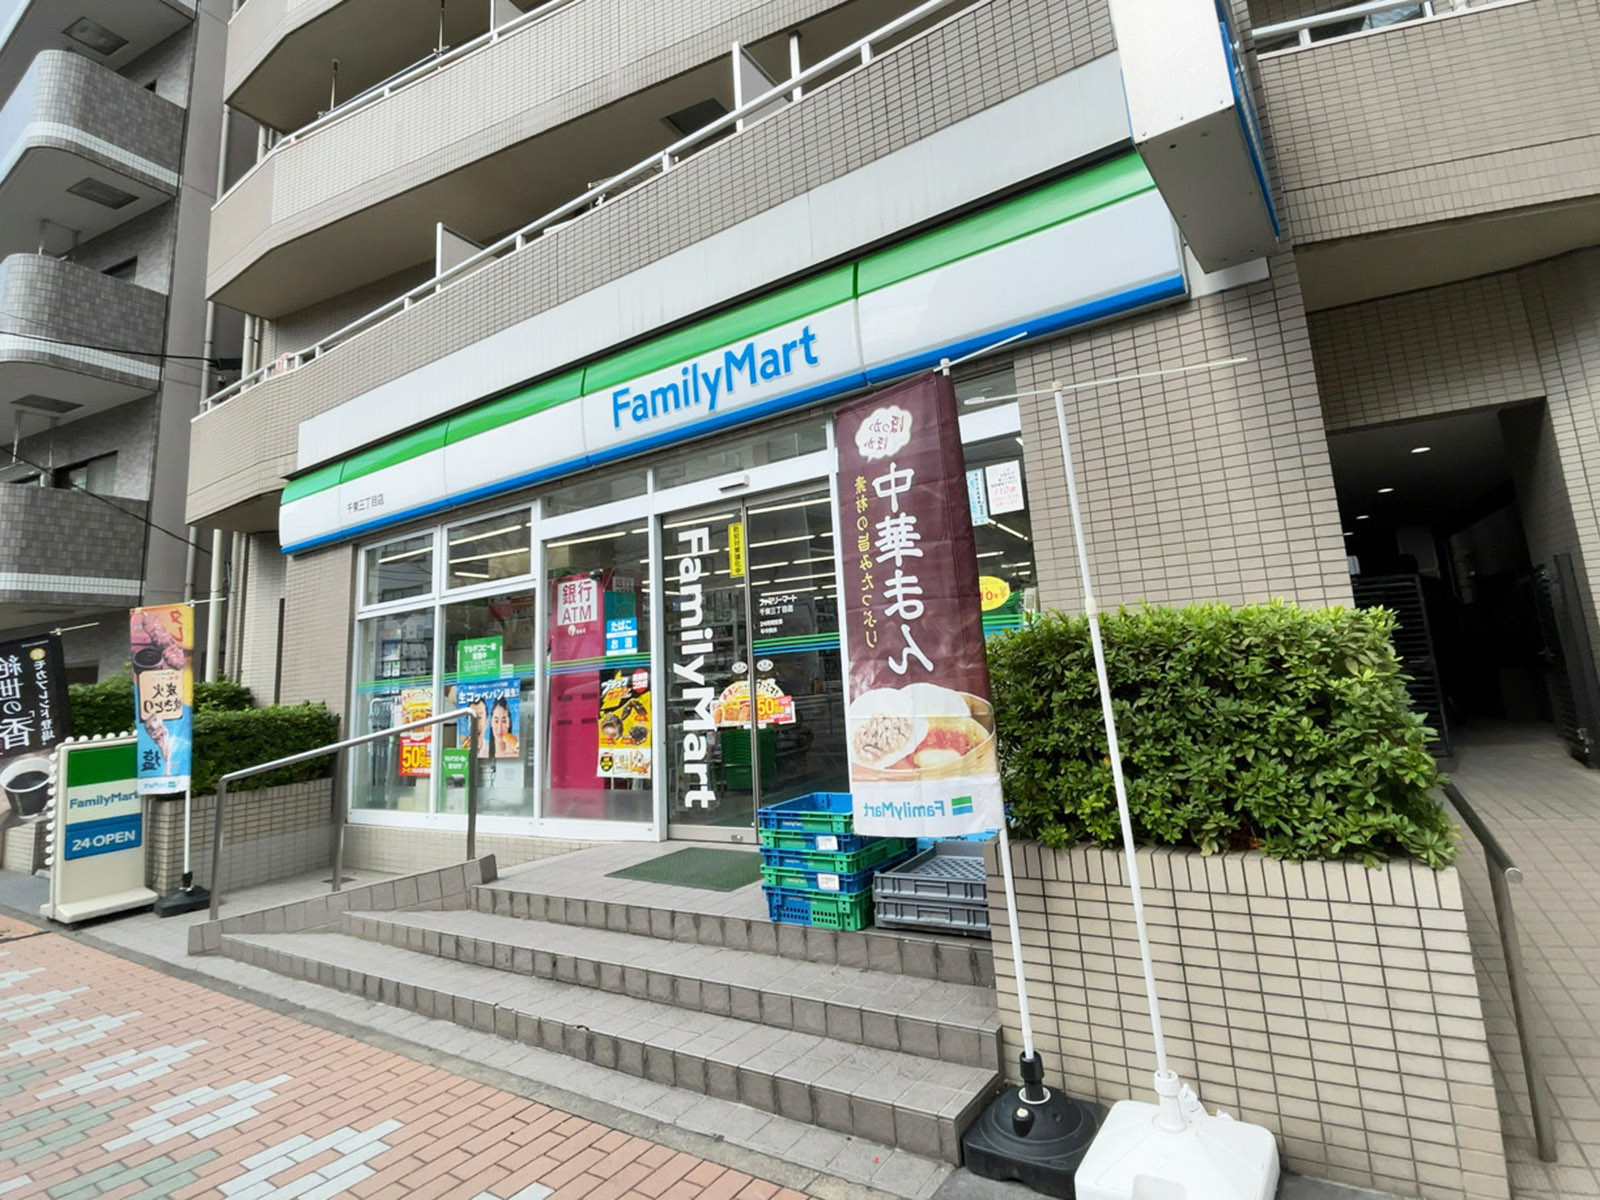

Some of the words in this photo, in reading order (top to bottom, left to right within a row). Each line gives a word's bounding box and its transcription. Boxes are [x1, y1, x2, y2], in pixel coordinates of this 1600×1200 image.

[612, 325, 818, 429] FamilyMart
[562, 580, 592, 605] 銀行
[562, 604, 592, 624] ATM
[672, 526, 717, 809] FamilyMart
[69, 791, 139, 809] FamilyMart
[72, 837, 91, 851] 24
[92, 830, 136, 847] OPEN
